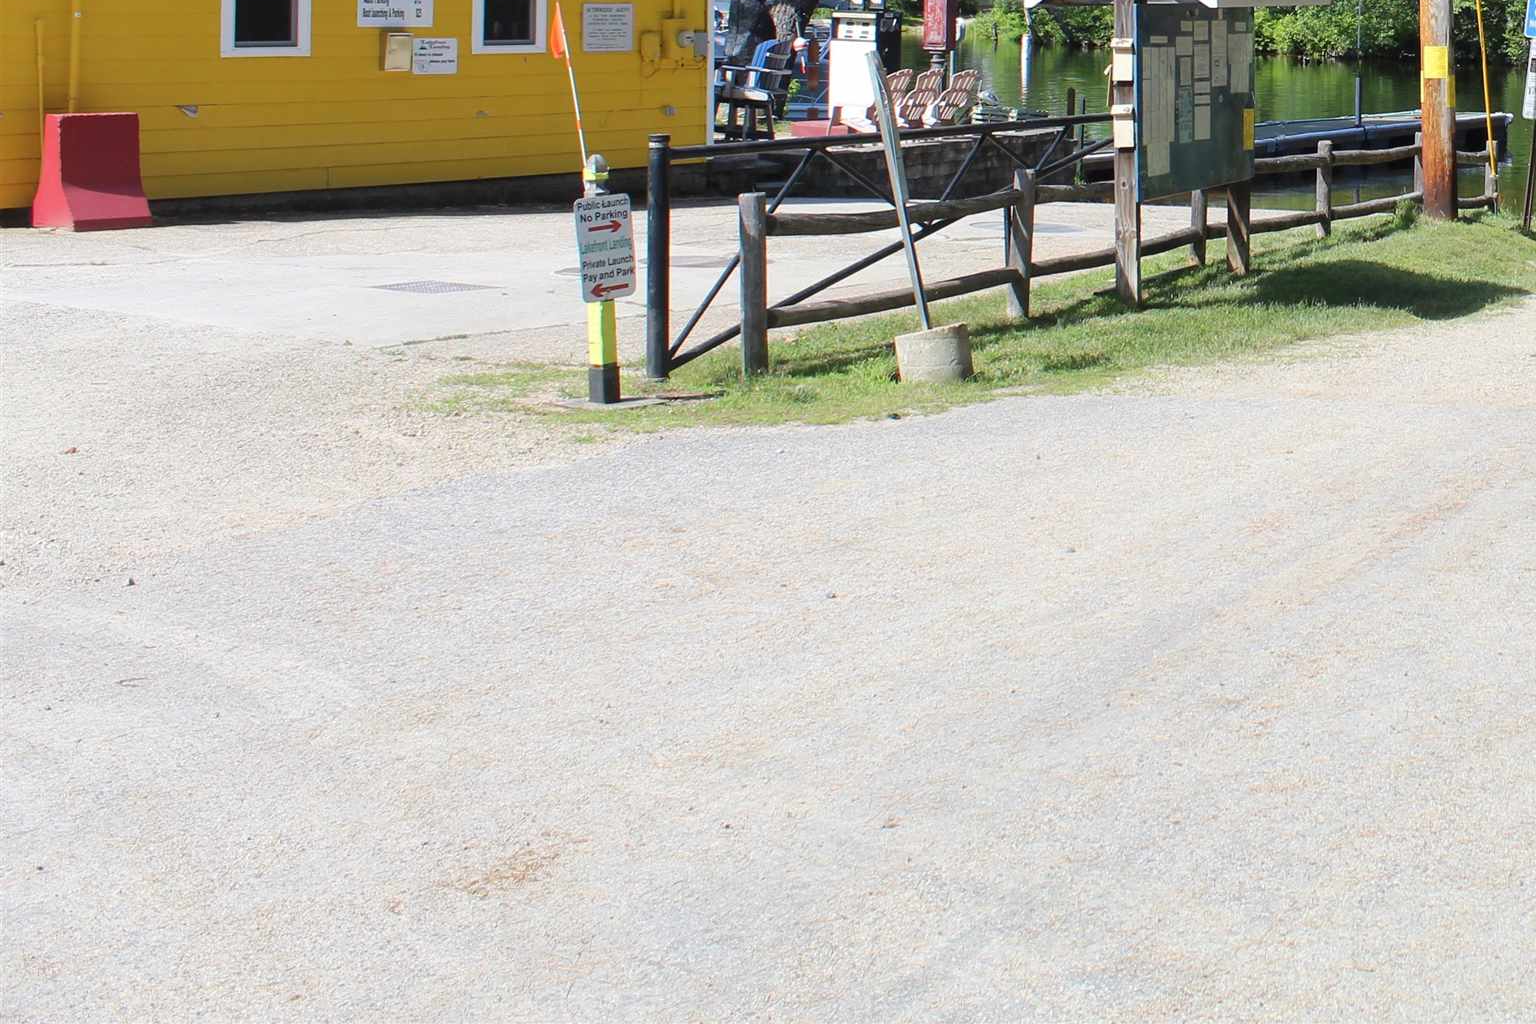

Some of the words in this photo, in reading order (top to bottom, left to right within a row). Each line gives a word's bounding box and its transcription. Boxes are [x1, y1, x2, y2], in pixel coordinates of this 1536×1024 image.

[577, 200, 601, 212] Public
[601, 197, 629, 209] Launch
[580, 212, 593, 223] No
[594, 209, 629, 222] Parking
[583, 258, 606, 270] Private
[607, 254, 634, 266] Launch
[583, 272, 598, 284] Pay
[598, 269, 615, 280] and
[616, 267, 635, 278] Park
